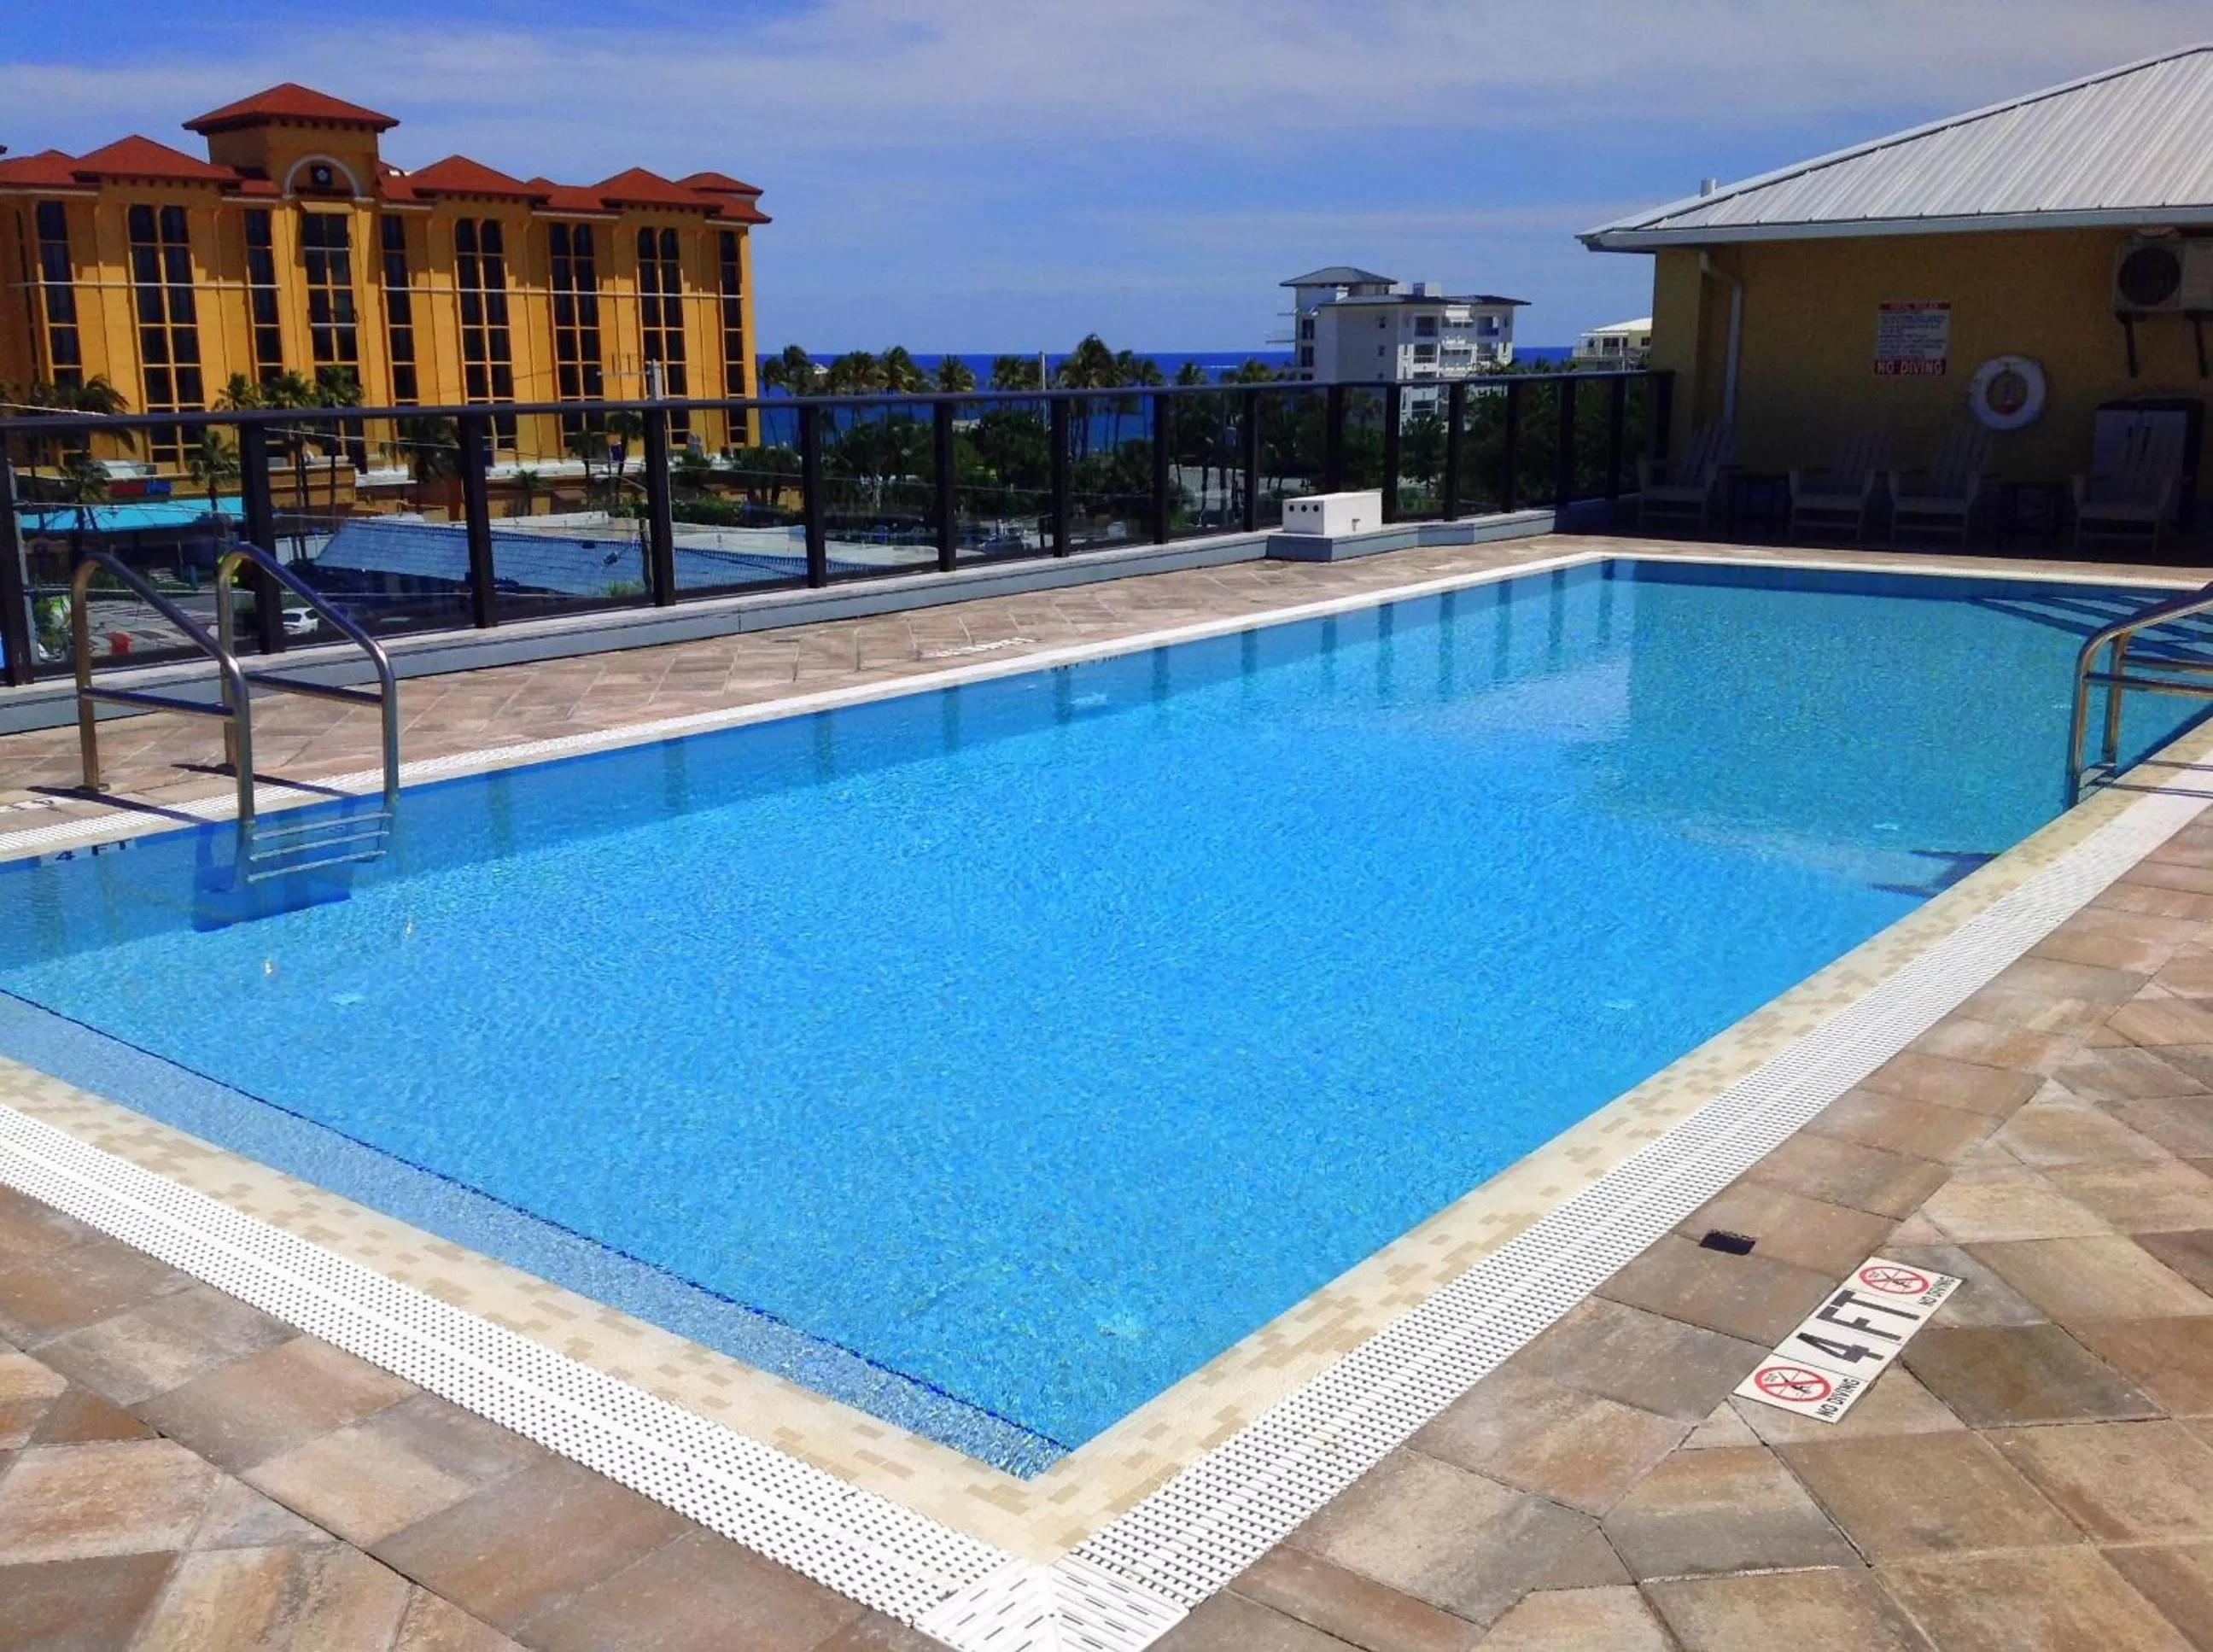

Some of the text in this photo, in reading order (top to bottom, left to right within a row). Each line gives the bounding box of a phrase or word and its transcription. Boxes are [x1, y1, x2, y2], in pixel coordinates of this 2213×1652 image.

[1877, 360, 1942, 375] NO DIVING
[55, 849, 77, 861] 4
[1796, 1289, 1921, 1364] 4 FT
[1815, 1377, 1860, 1418] NO DIVING
